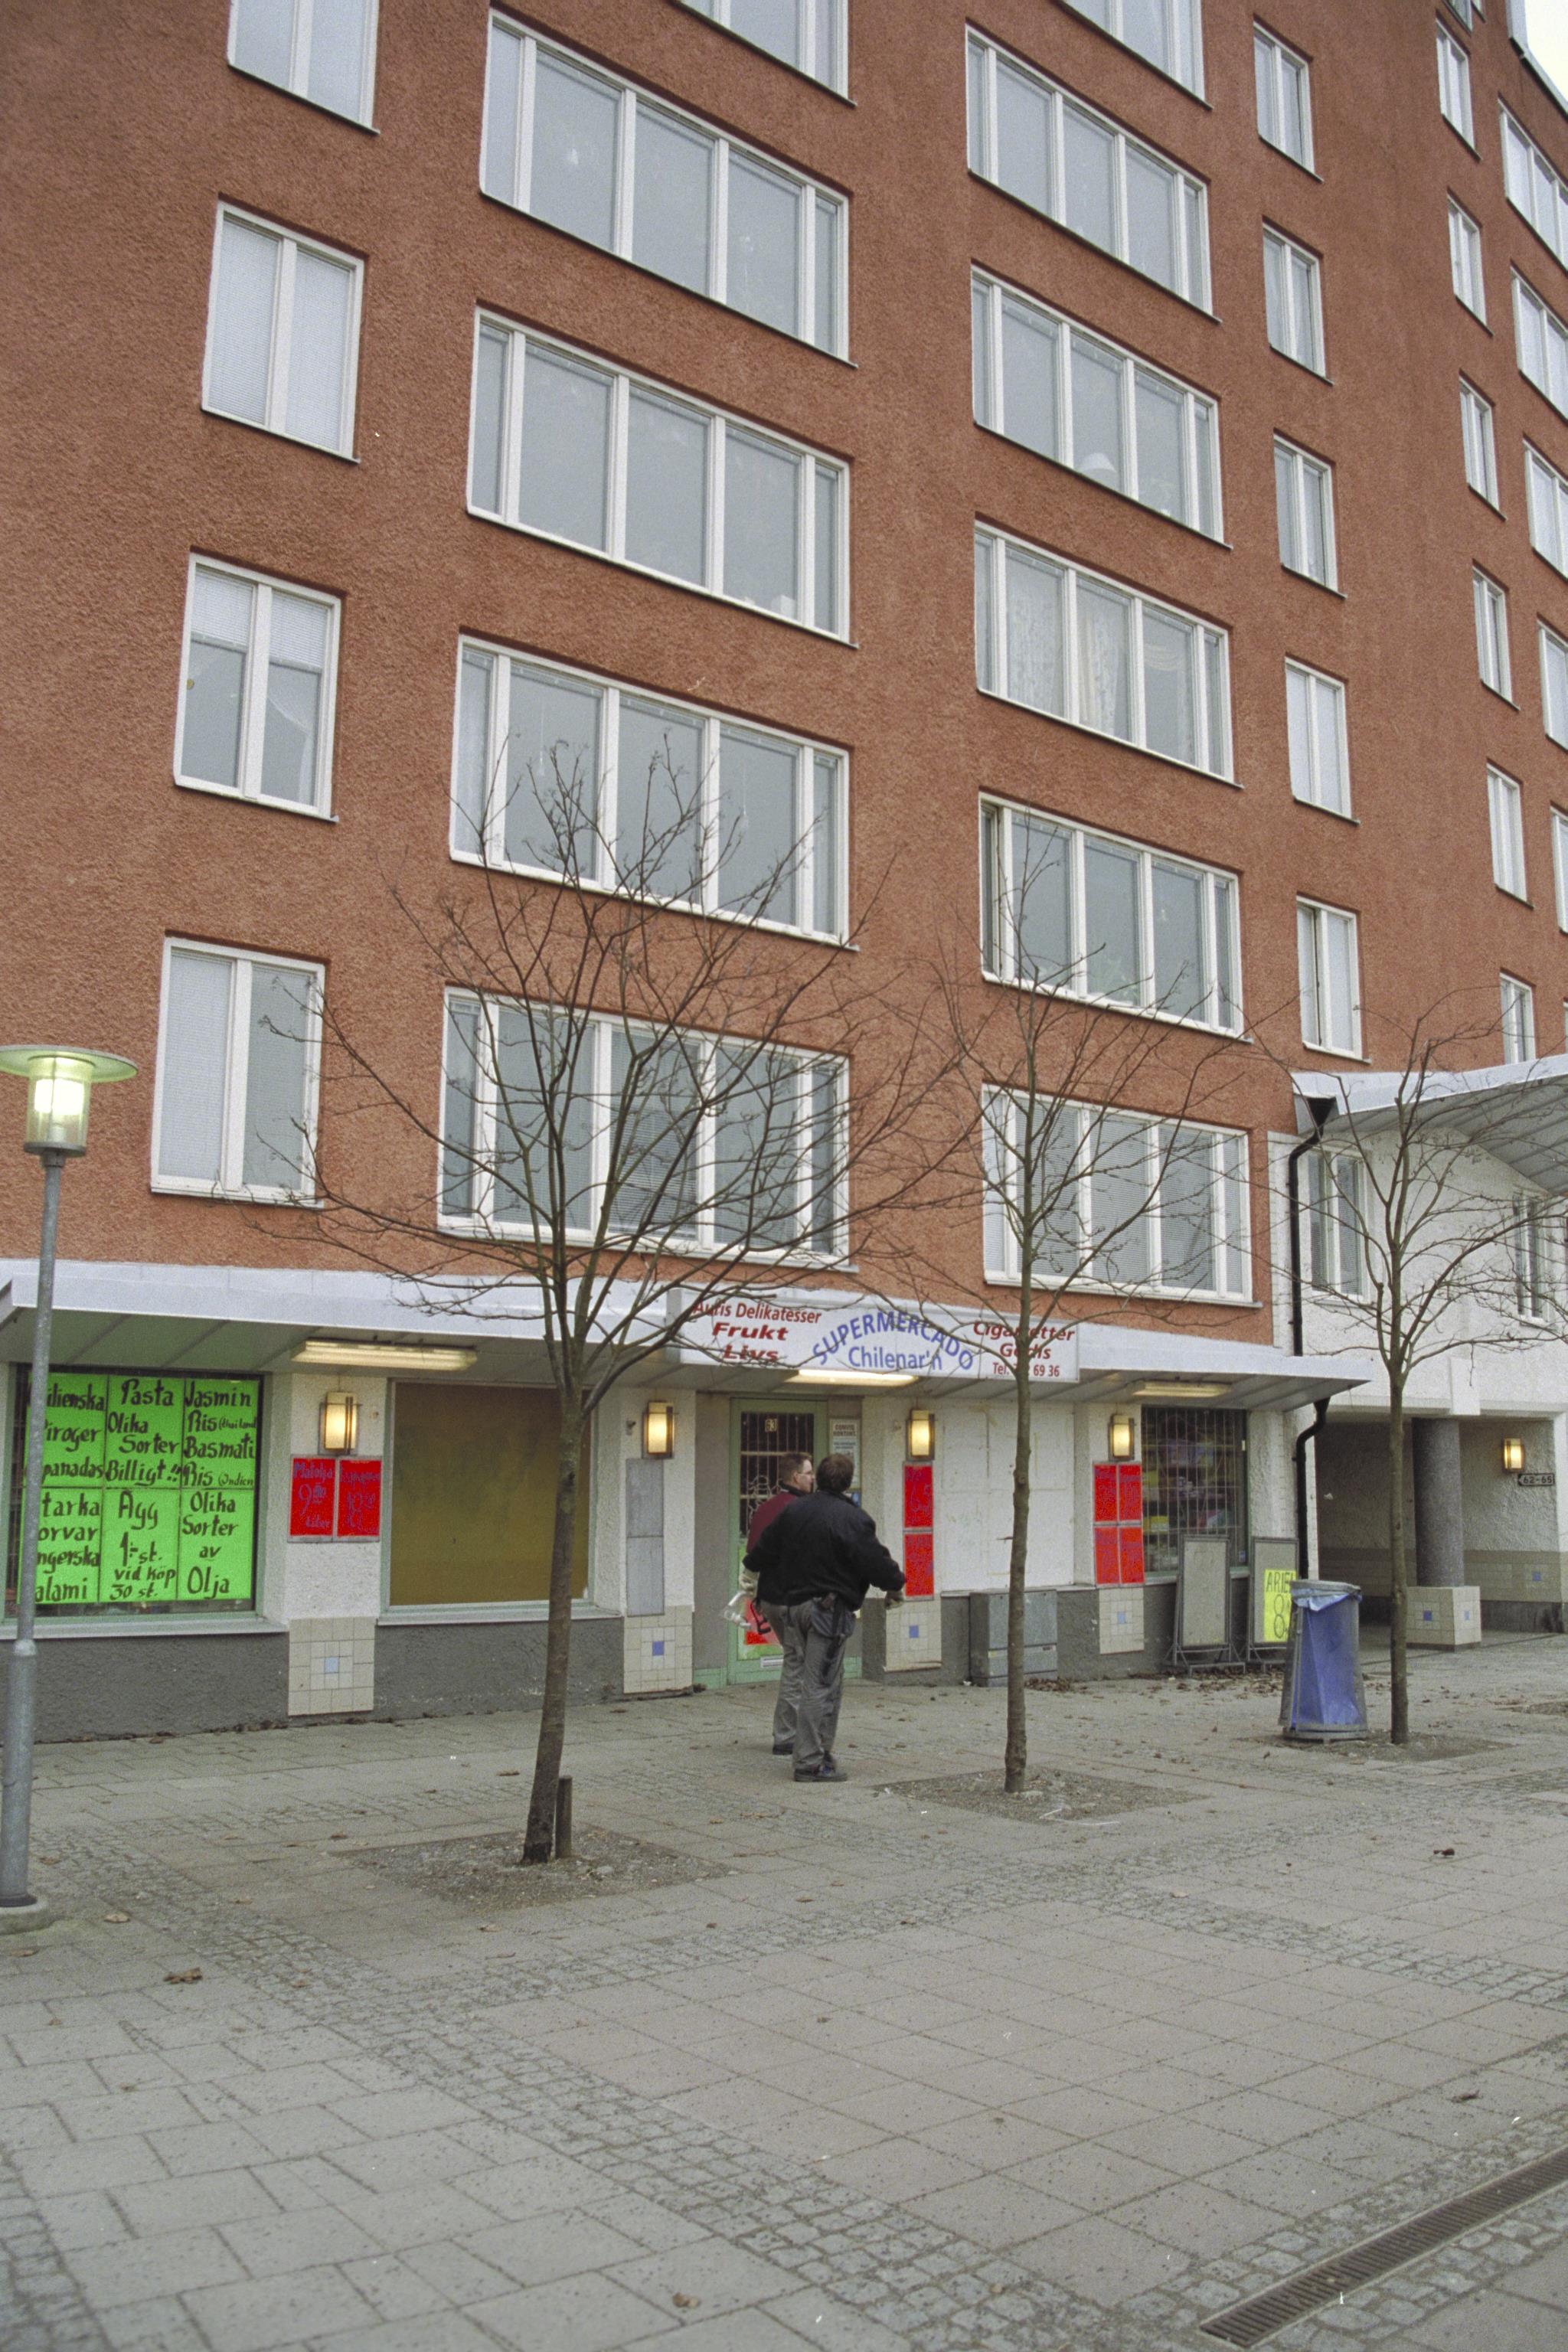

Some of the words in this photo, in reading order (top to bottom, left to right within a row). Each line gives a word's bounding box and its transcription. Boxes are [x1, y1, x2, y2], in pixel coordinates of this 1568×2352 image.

[736, 1302, 822, 1324] Delikatesser
[712, 1322, 789, 1341] Frukt
[812, 1311, 973, 1370] SUPERMERCADO
[722, 1344, 779, 1362] Livs
[992, 1363, 1009, 1375] Tel.
[1034, 1364, 1045, 1377] 69
[1048, 1364, 1060, 1377] 36
[122, 1379, 174, 1406] Pasta
[185, 1380, 251, 1408] Jasmin
[107, 1411, 149, 1434] Olika
[188, 1410, 217, 1433] Ris
[44, 1419, 101, 1452] iroger
[119, 1433, 181, 1455] Sorter
[184, 1433, 255, 1459] Basmati
[42, 1456, 103, 1483] panadas
[184, 1462, 213, 1487] Ris
[1524, 1475, 1552, 1485] 62-65
[42, 1491, 100, 1517] tarka
[190, 1491, 236, 1514] Olika
[38, 1527, 98, 1541] orvar
[182, 1514, 238, 1537] Sorter
[37, 1545, 100, 1574] ngerska
[199, 1546, 222, 1560] av
[115, 1566, 141, 1582] vid
[188, 1566, 230, 1599] Olja
[35, 1576, 87, 1602] alami
[109, 1584, 132, 1601] 30
